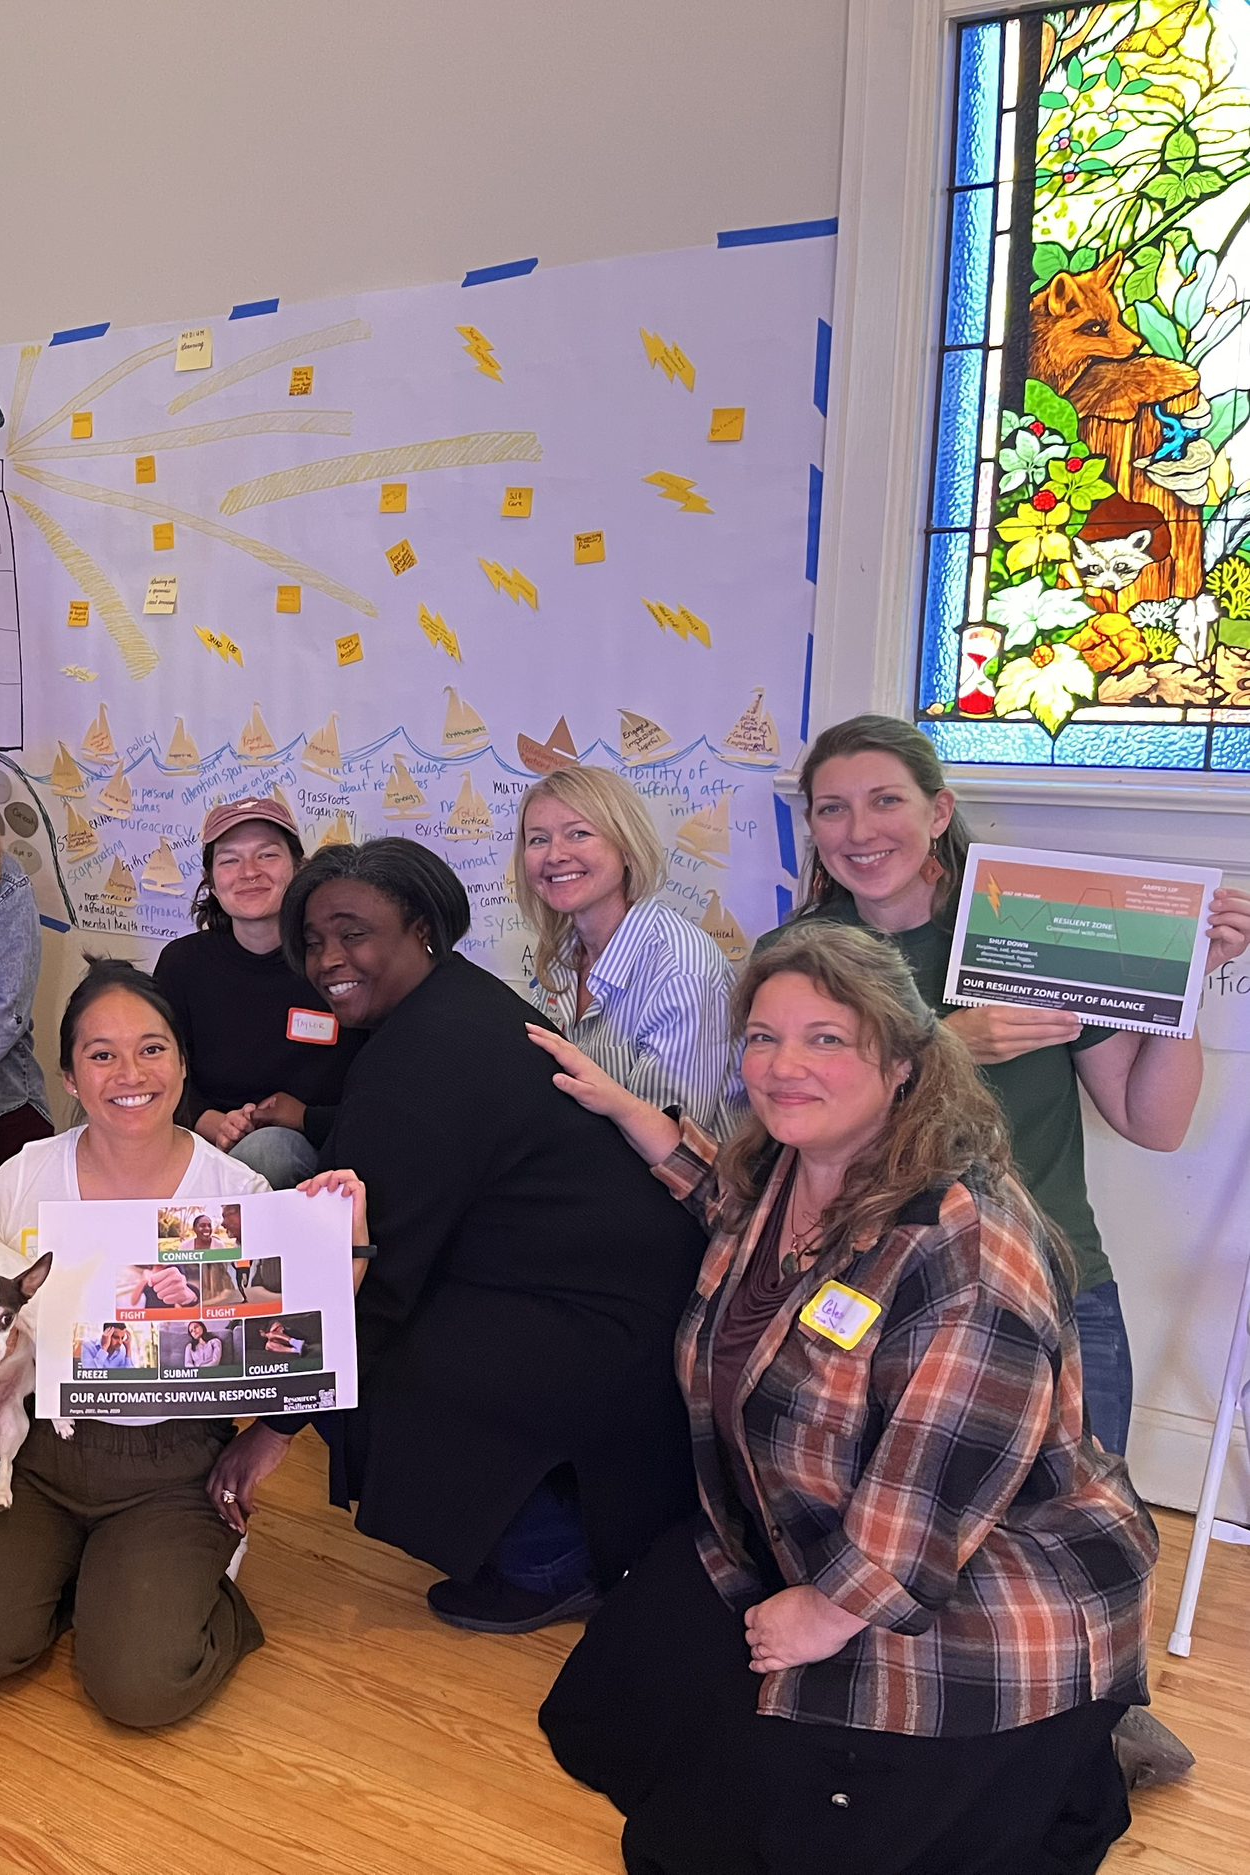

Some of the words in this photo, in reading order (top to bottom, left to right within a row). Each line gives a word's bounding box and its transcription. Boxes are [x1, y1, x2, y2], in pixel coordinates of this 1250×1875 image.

[126, 731, 162, 763] policy
[360, 760, 375, 778] of
[381, 760, 448, 780] knwledge
[689, 761, 709, 780] of
[181, 773, 222, 806] attention
[339, 778, 366, 793] about
[700, 778, 746, 796] after
[142, 788, 174, 804] personal
[298, 788, 350, 807] grassroots
[132, 803, 160, 813] aumas
[445, 846, 498, 870] burnout
[82, 918, 111, 931] mental
[113, 917, 139, 933] health
[1046, 925, 1080, 935] Connected
[1053, 917, 1090, 928] RESILIENT
[1091, 921, 1113, 931] ZONE
[989, 938, 1006, 946] SHUT
[1007, 940, 1029, 949] DOWN
[963, 978, 984, 988] OUR
[986, 981, 1032, 995] RESILIENT
[1033, 988, 1060, 999] ZONE
[1061, 991, 1083, 1003] OUT
[1085, 995, 1099, 1005] OF
[1100, 997, 1146, 1012] BALANCE
[162, 1251, 204, 1261] CONNECT
[120, 1310, 146, 1320] FIGHT
[206, 1307, 236, 1318] FLIGHT
[77, 1369, 108, 1379] FREEZE
[163, 1368, 199, 1379] SUBMIT
[248, 1363, 289, 1375] COLLAPSE
[69, 1391, 95, 1404] OUR
[96, 1390, 163, 1403] AUTOMATIC
[164, 1388, 217, 1402] SURVIVAL
[219, 1387, 277, 1402] RESPONSES
[283, 1395, 317, 1404] Resources
